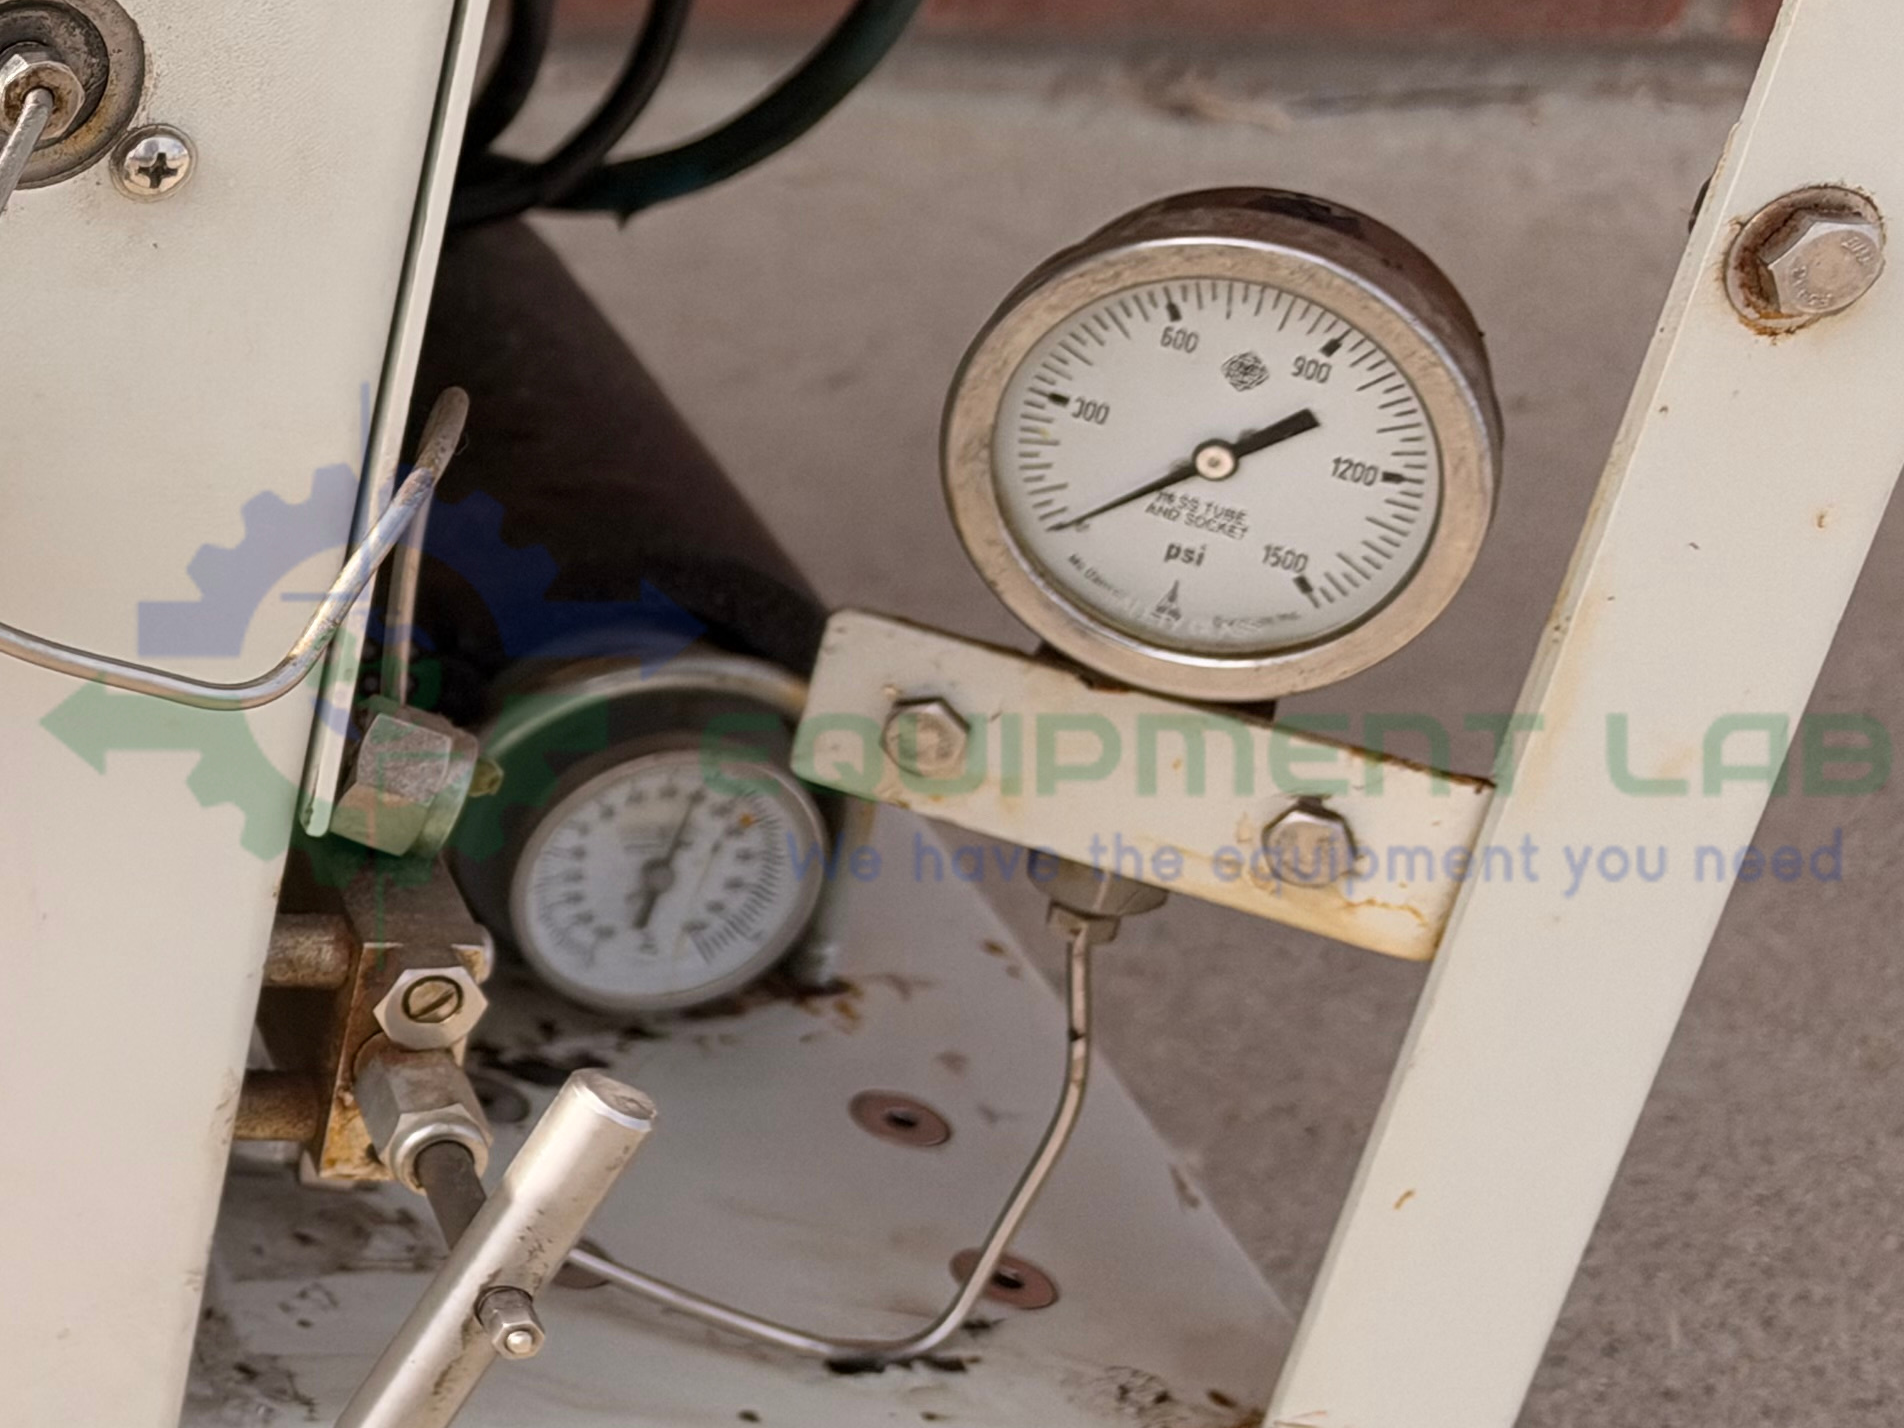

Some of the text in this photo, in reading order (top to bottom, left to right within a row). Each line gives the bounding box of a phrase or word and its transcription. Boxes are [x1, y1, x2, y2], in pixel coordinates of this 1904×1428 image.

[1160, 327, 1198, 354] 600
[1292, 356, 1331, 384] 900
[1331, 456, 1378, 486] 1200
[1204, 502, 1247, 524] TUBE
[1164, 542, 1207, 567] psi
[1262, 544, 1309, 573] 1500
